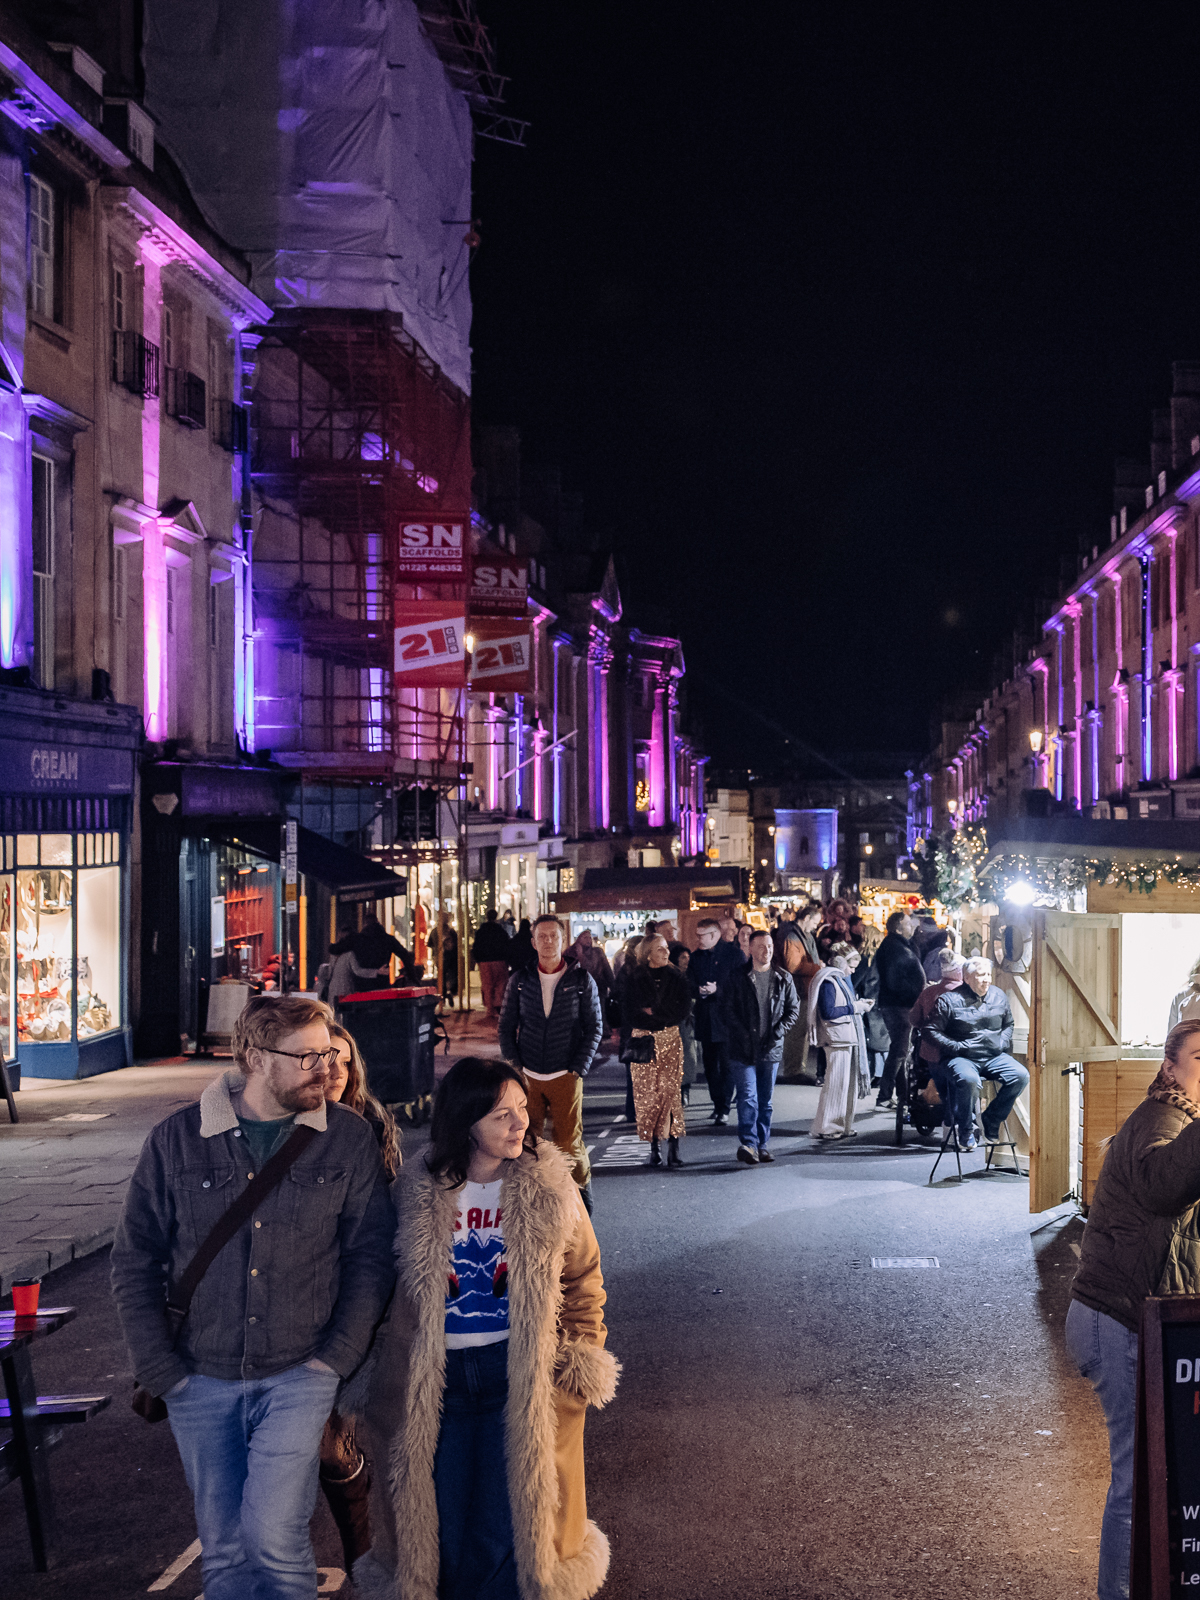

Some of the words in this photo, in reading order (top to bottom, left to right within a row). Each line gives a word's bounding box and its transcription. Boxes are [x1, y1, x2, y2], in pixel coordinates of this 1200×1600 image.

[402, 524, 462, 547] SN
[401, 549, 461, 557] SCAFFOLDS
[474, 567, 527, 588] SN
[399, 628, 447, 661] 21
[31, 750, 78, 780] CREAM
